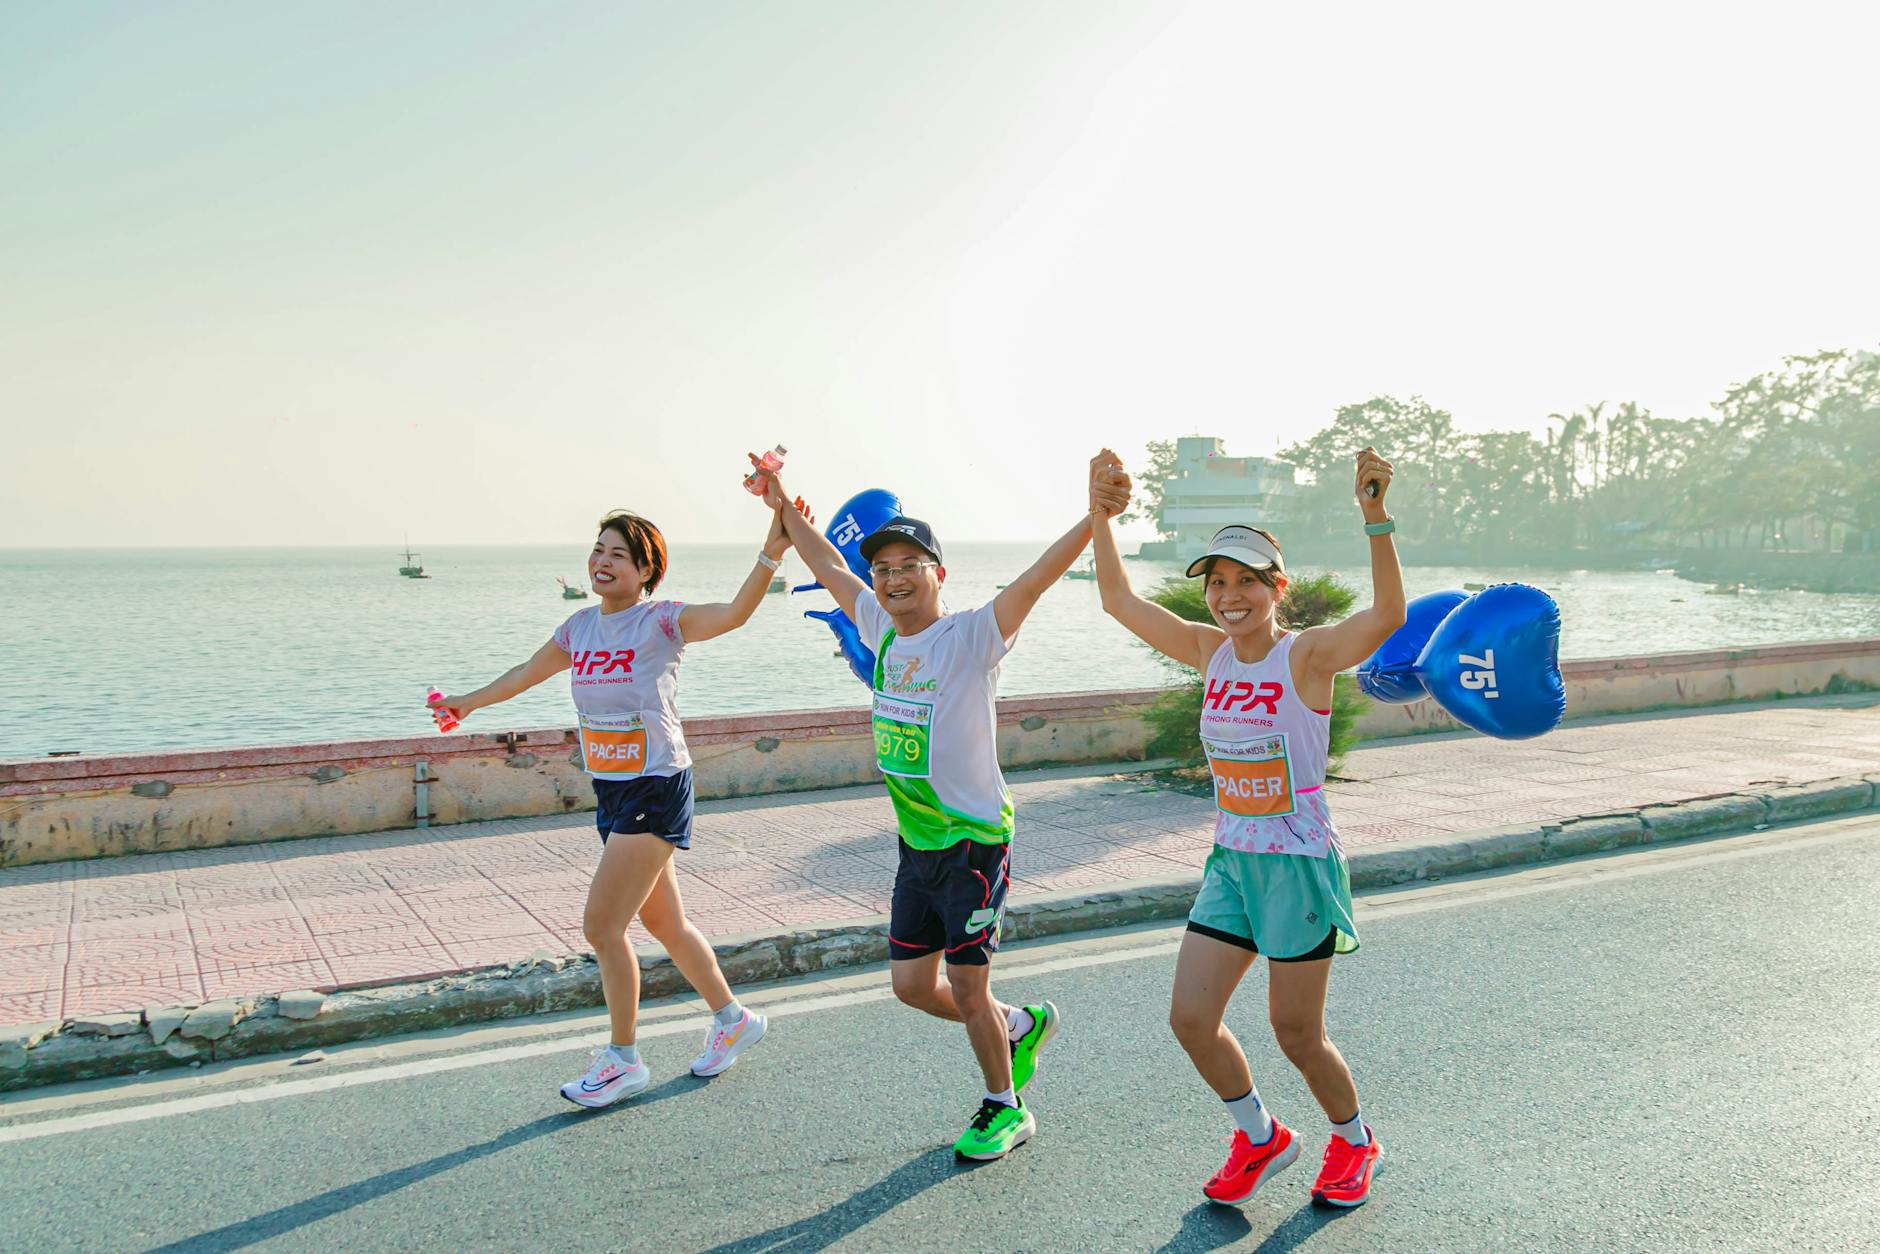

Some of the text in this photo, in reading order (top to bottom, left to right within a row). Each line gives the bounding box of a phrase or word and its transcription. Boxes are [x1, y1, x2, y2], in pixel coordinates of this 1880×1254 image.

[832, 513, 864, 546] 75'
[574, 649, 635, 675] HPR
[598, 677, 633, 685] RUNNERS
[1459, 649, 1499, 699] 75'
[1202, 678, 1284, 714] HPR
[890, 705, 900, 715] FOR
[901, 707, 915, 718] KIDS
[1205, 715, 1273, 727] PHONG RUNNERS
[589, 742, 641, 759] PACER
[1245, 745, 1266, 755] KIDS
[1215, 775, 1283, 798] PACER
